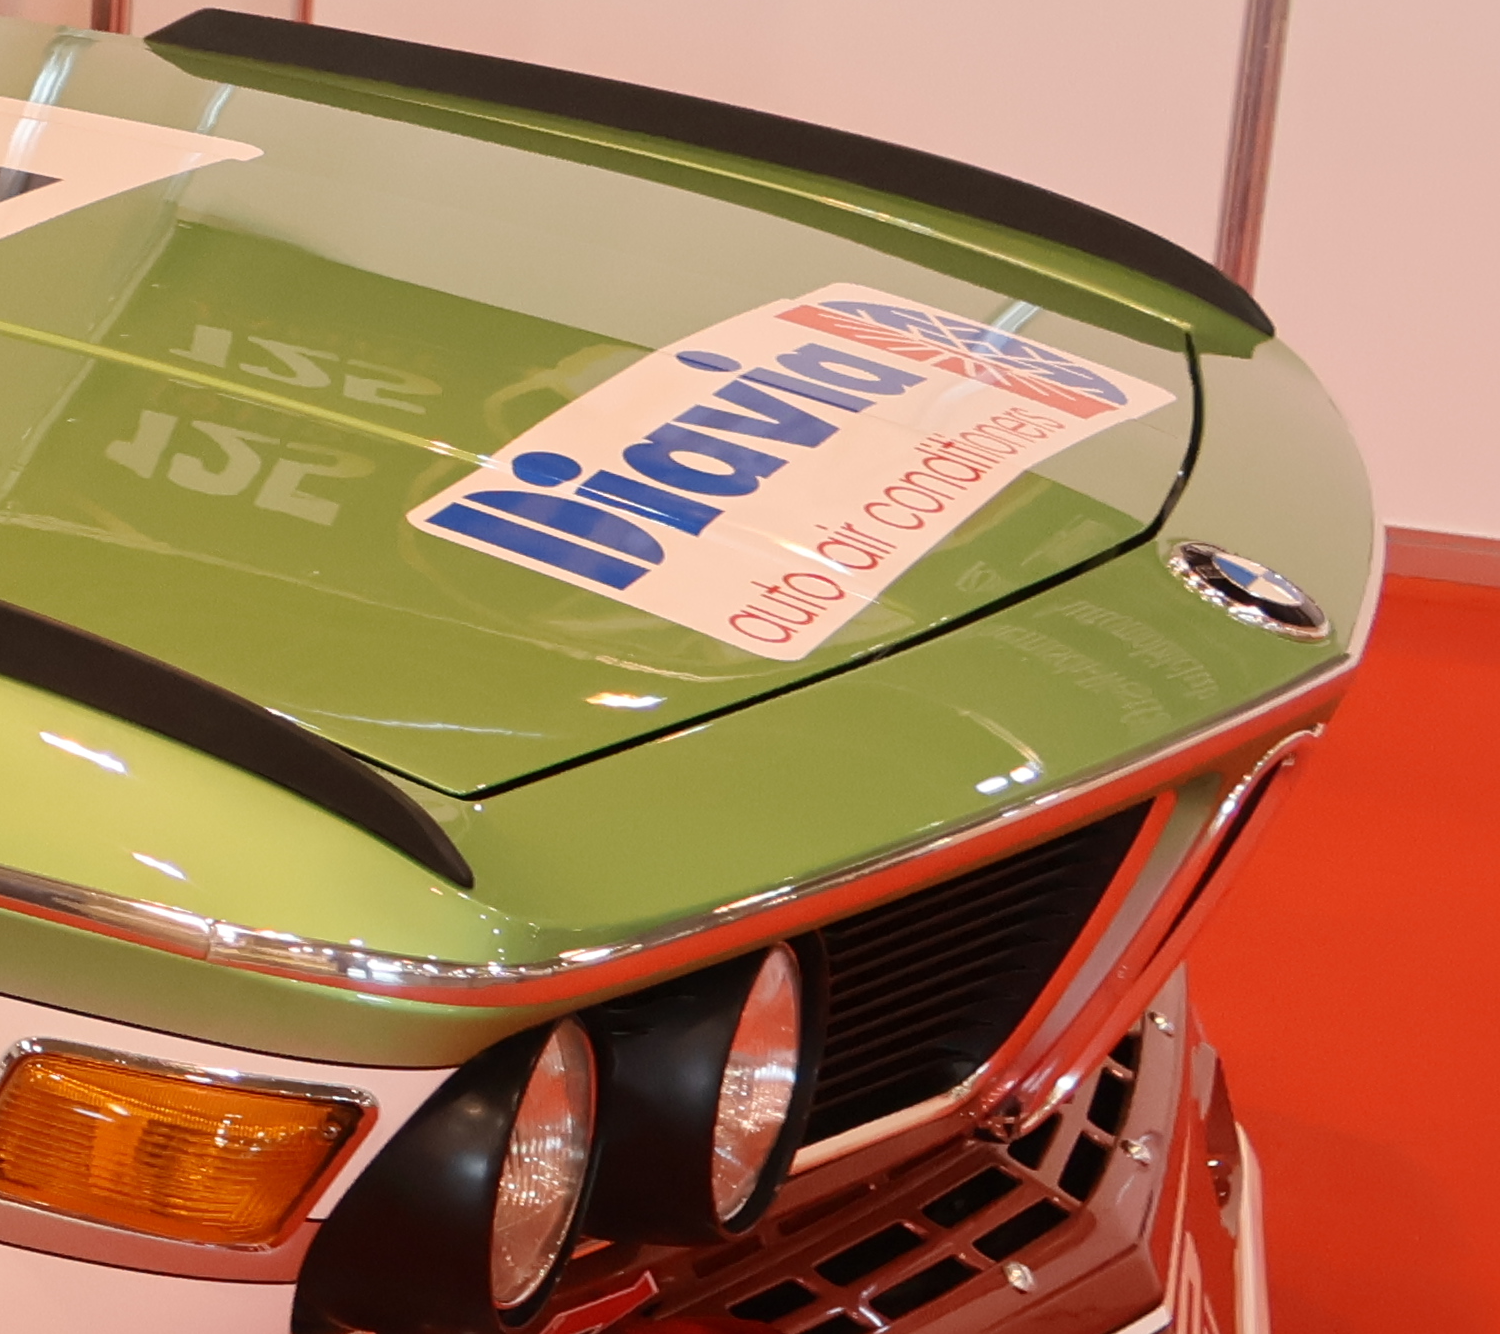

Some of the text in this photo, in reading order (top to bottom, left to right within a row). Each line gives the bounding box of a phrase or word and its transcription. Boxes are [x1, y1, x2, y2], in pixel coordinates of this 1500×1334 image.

[423, 342, 929, 592] Diavia
[729, 407, 1066, 644] auto air conditioners
